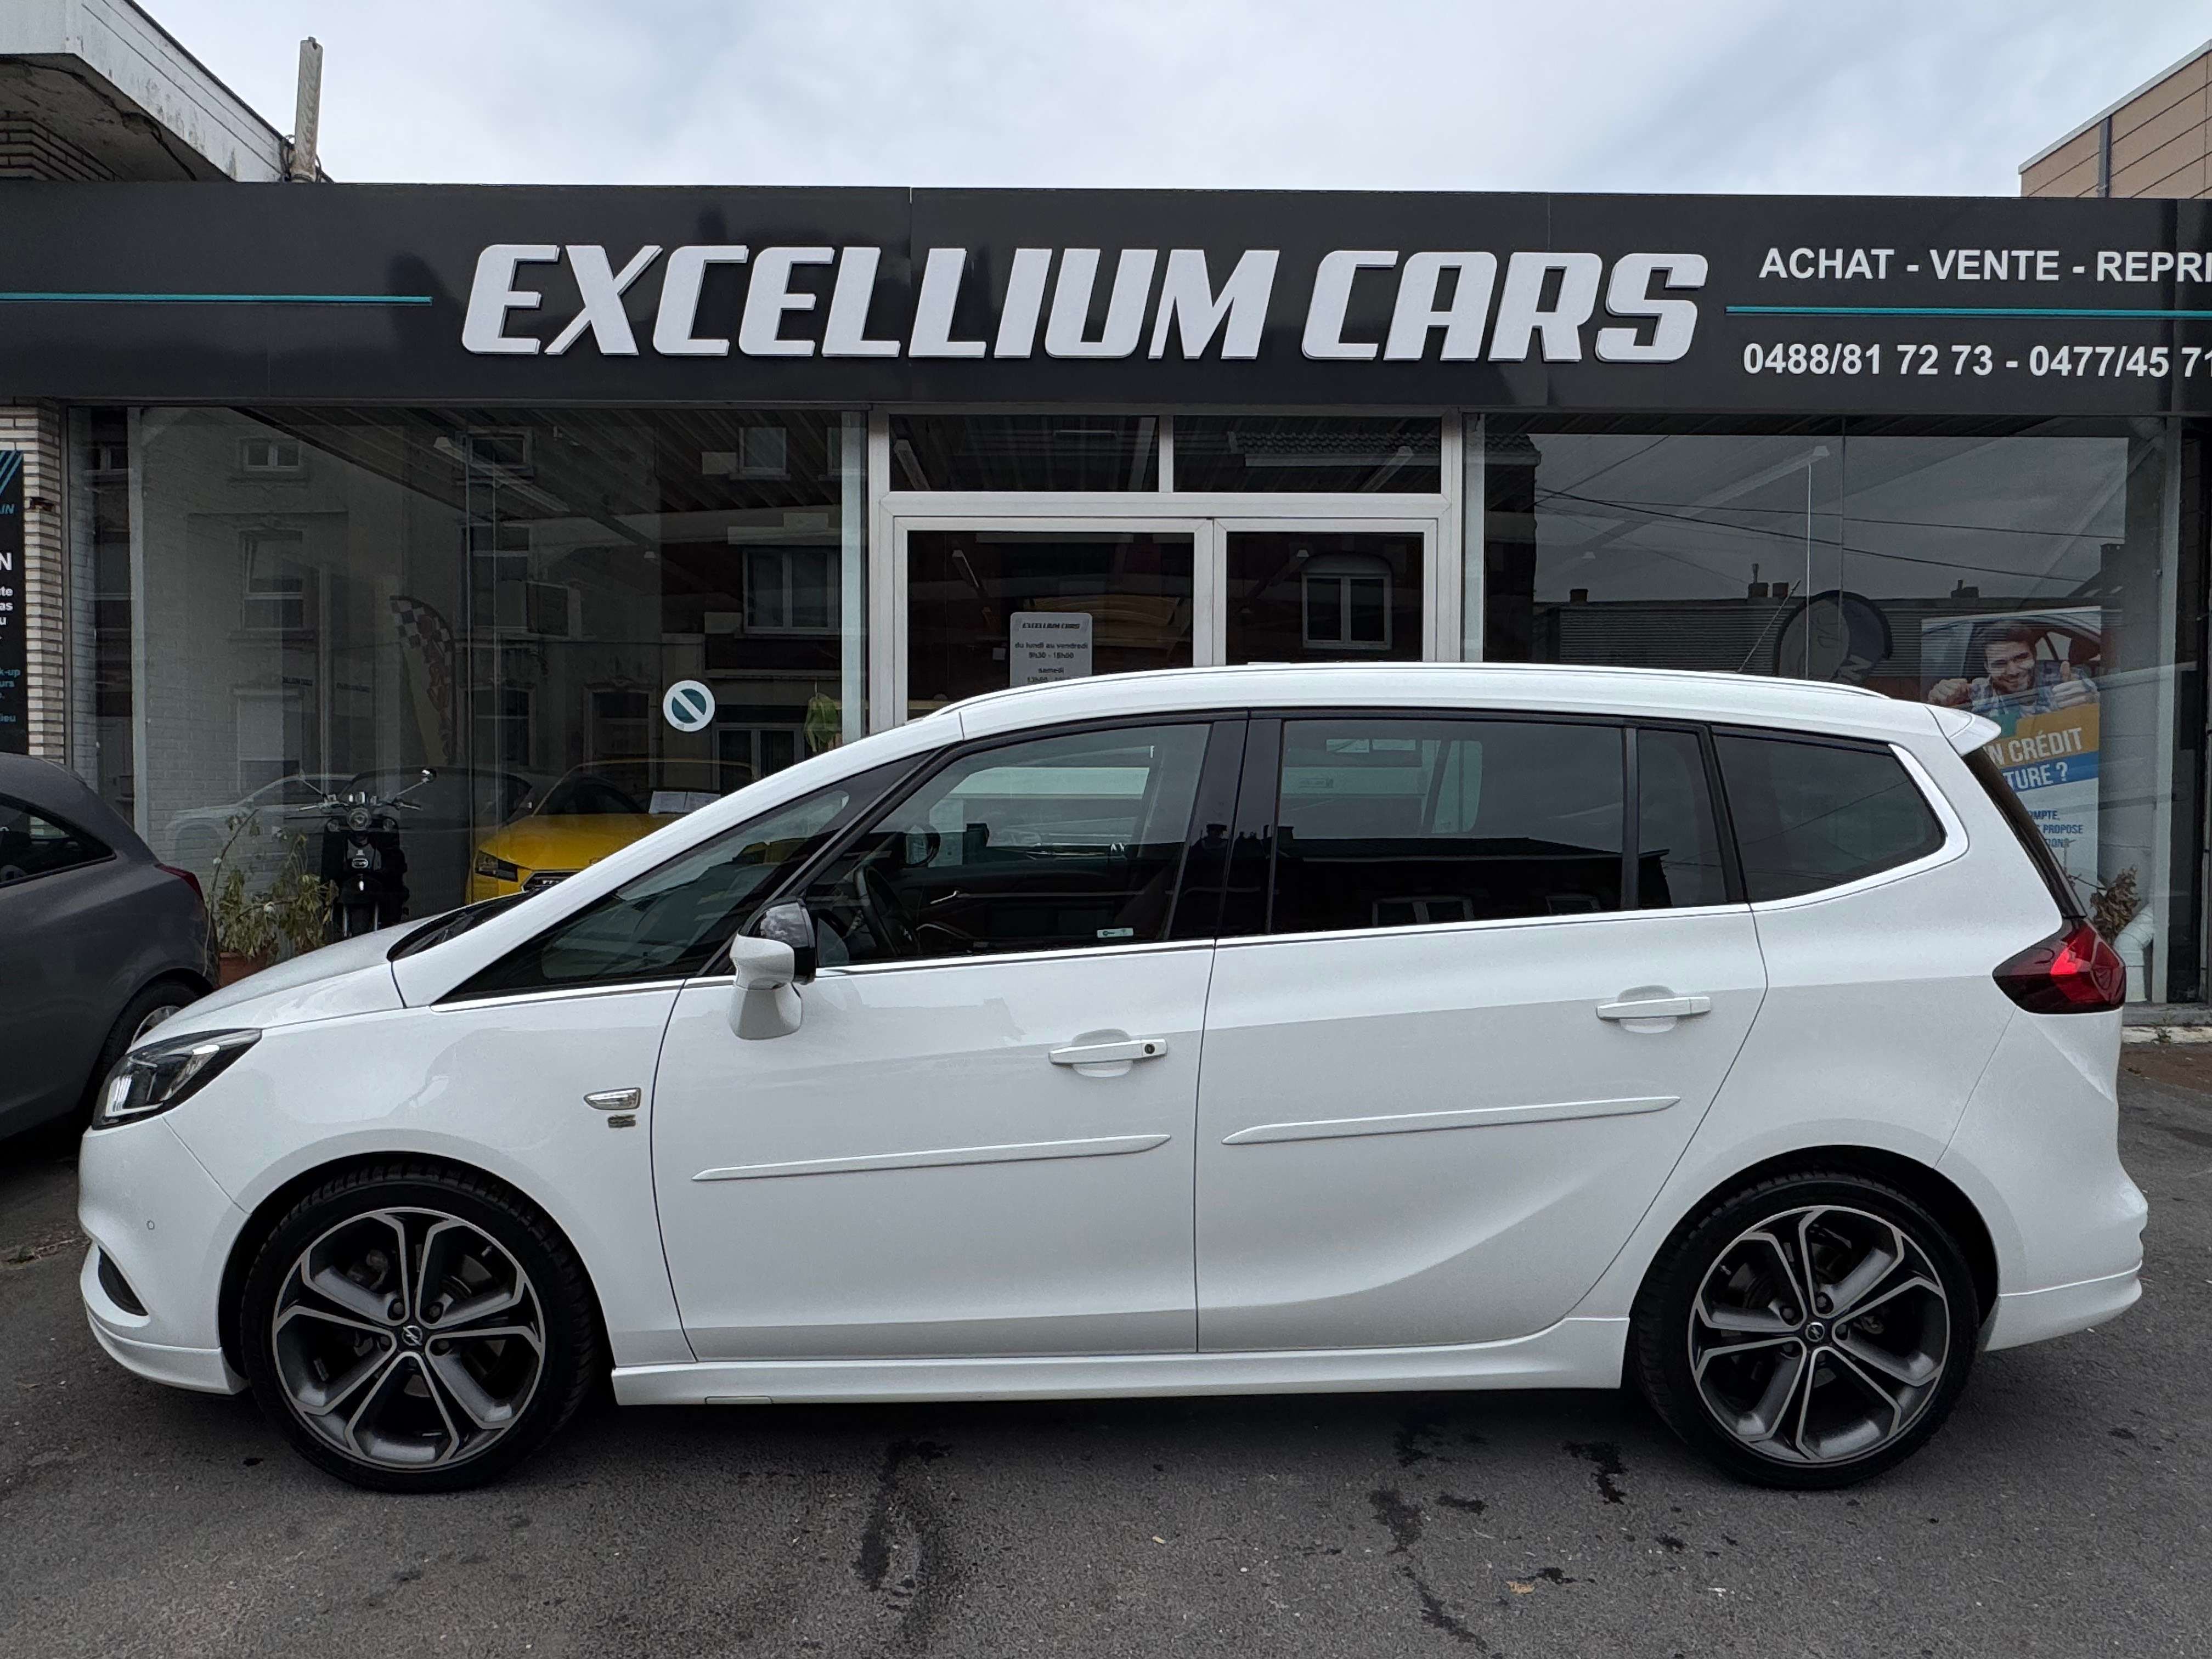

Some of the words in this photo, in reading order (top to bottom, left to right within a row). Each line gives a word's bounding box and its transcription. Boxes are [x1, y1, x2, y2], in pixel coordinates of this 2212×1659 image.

[1759, 248, 1895, 280] ACHAT
[1929, 249, 2060, 281] VENTE
[462, 244, 1280, 359] EXCELLIUM
[1301, 250, 1709, 362] CARS
[1743, 342, 1880, 375] 0488/81
[1897, 344, 1939, 375] 72
[1951, 345, 1993, 376] 73
[2030, 346, 2170, 378] 0477/45
[0, 585, 13, 597] te
[1983, 743, 2005, 765] N
[2008, 728, 2082, 762] CRÉDIT
[2056, 761, 2069, 782] ?
[2043, 823, 2084, 834] PROPOSE
